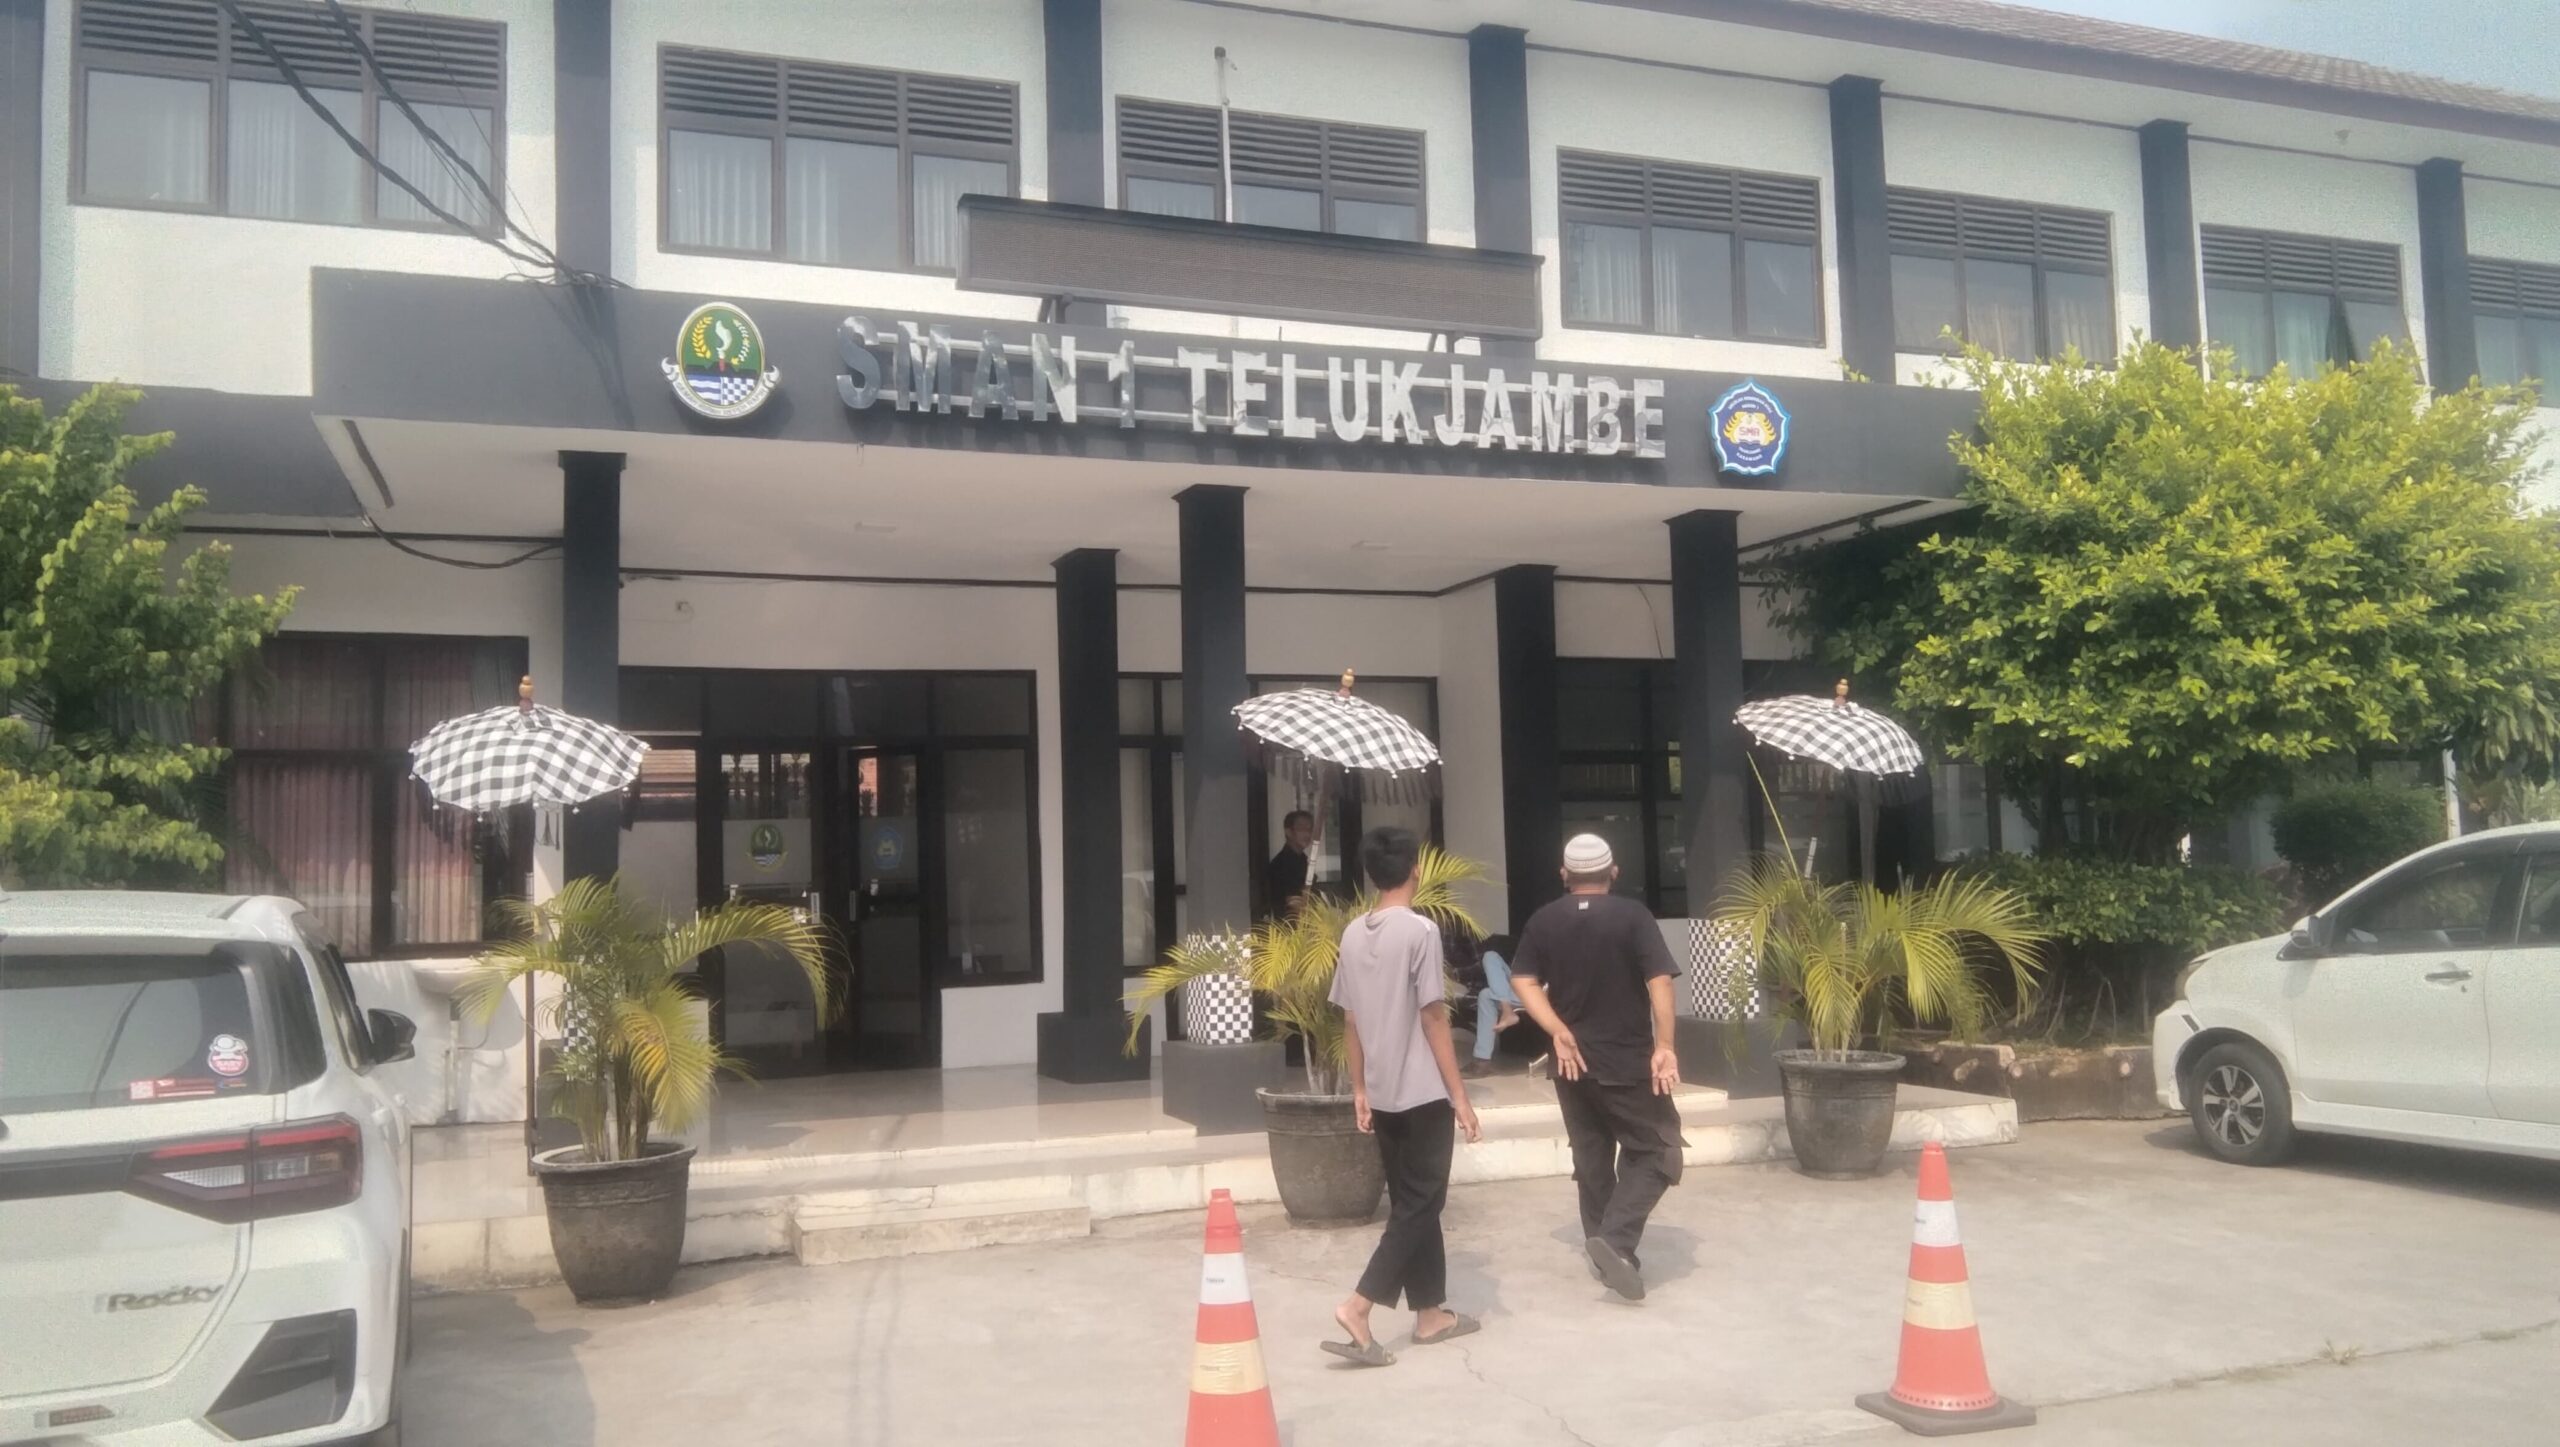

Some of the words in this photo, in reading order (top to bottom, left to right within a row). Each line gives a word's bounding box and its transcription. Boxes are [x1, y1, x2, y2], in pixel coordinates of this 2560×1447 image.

[836, 315, 1077, 422] SMAN
[1108, 340, 1136, 429] 1
[1177, 345, 1666, 458] TELUKJAMBE
[1739, 427, 1760, 437] SMA
[107, 1284, 224, 1313] Rocky
